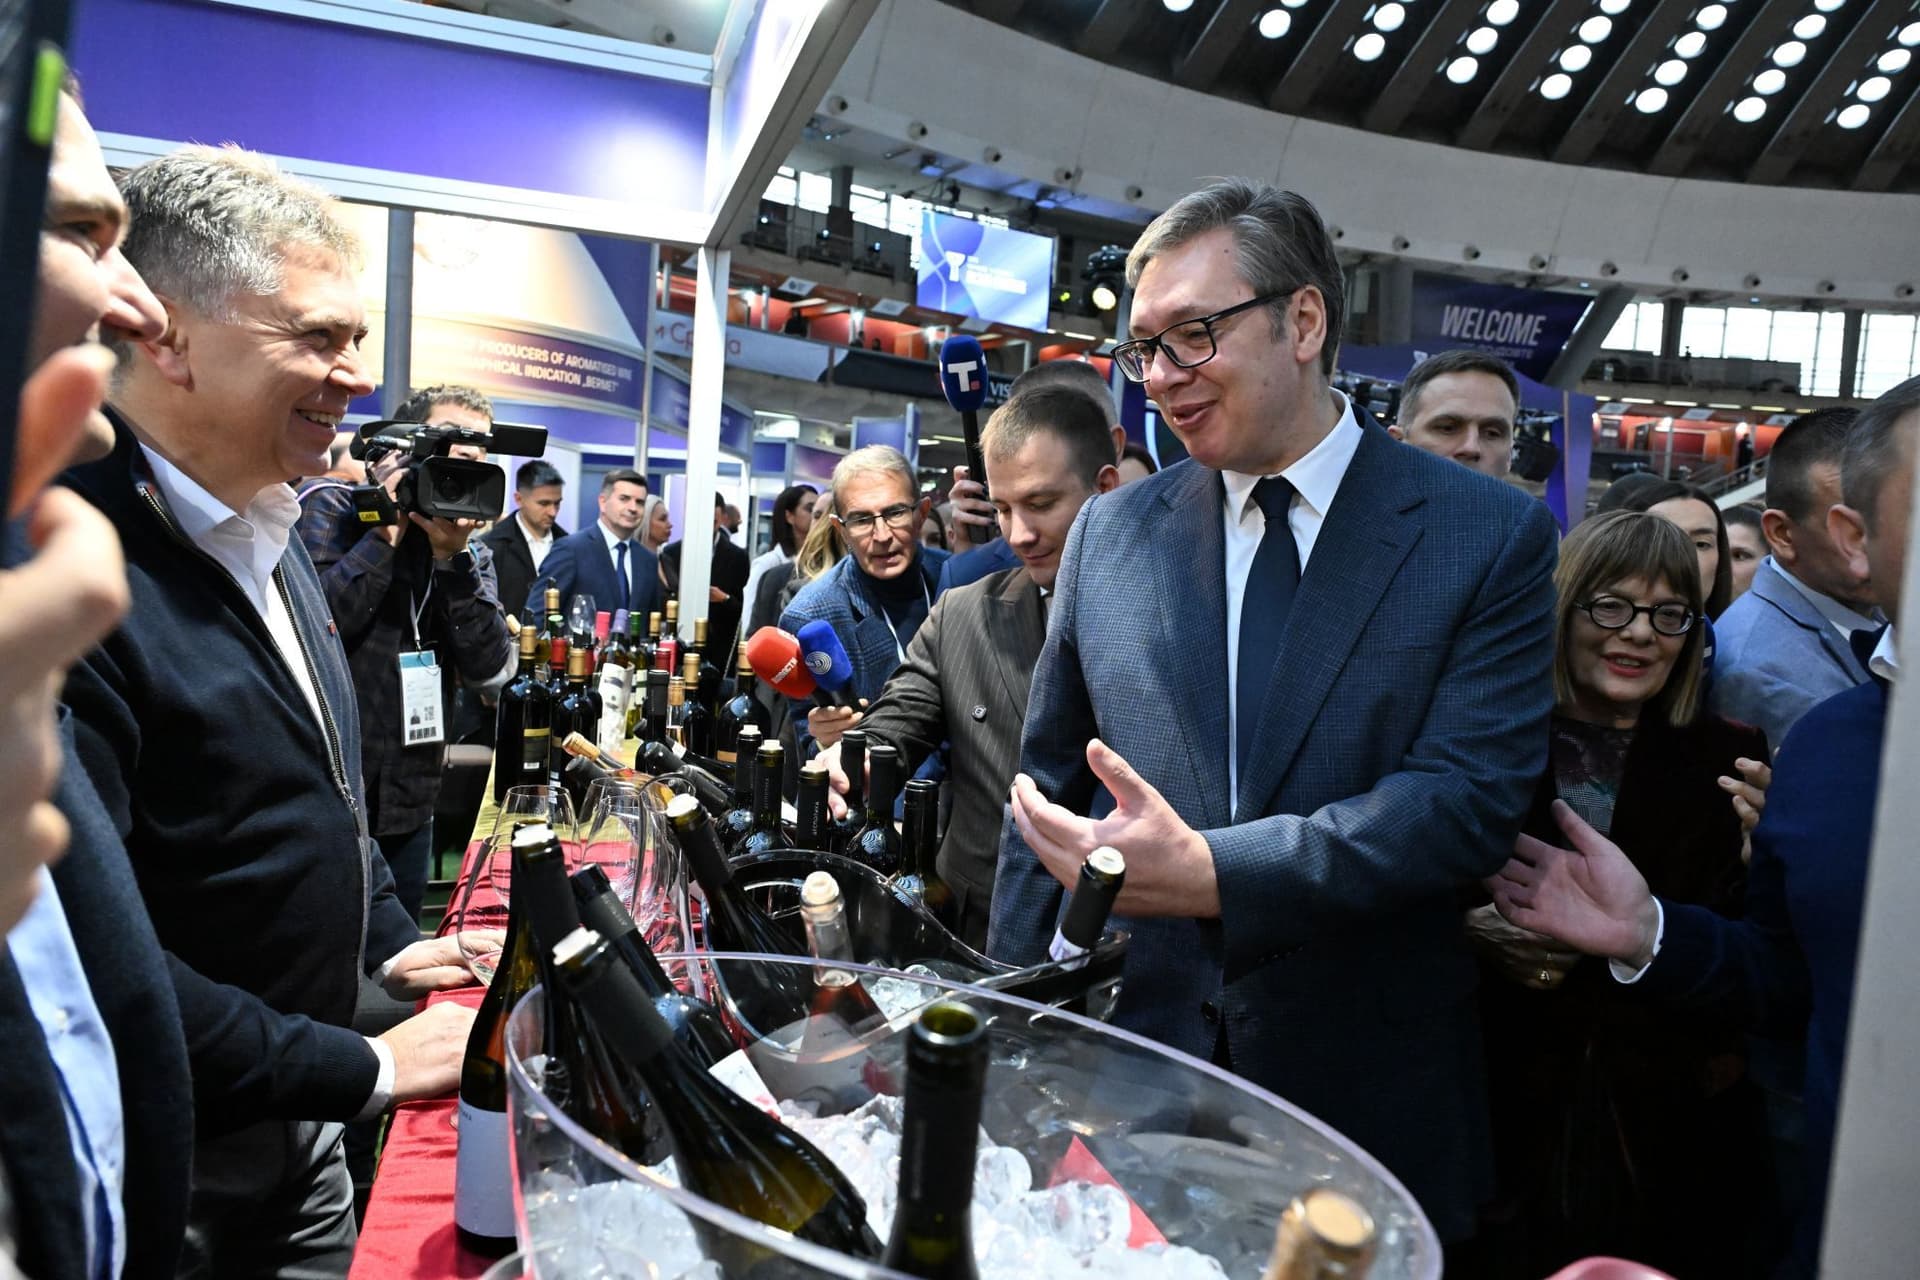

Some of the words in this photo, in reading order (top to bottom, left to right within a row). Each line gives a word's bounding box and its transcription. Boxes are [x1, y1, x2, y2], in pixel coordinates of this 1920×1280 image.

[1440, 304, 1547, 346] WELCOME
[479, 339, 549, 363] PRODUCERS
[551, 351, 564, 366] OF
[524, 364, 581, 386] INDICATION
